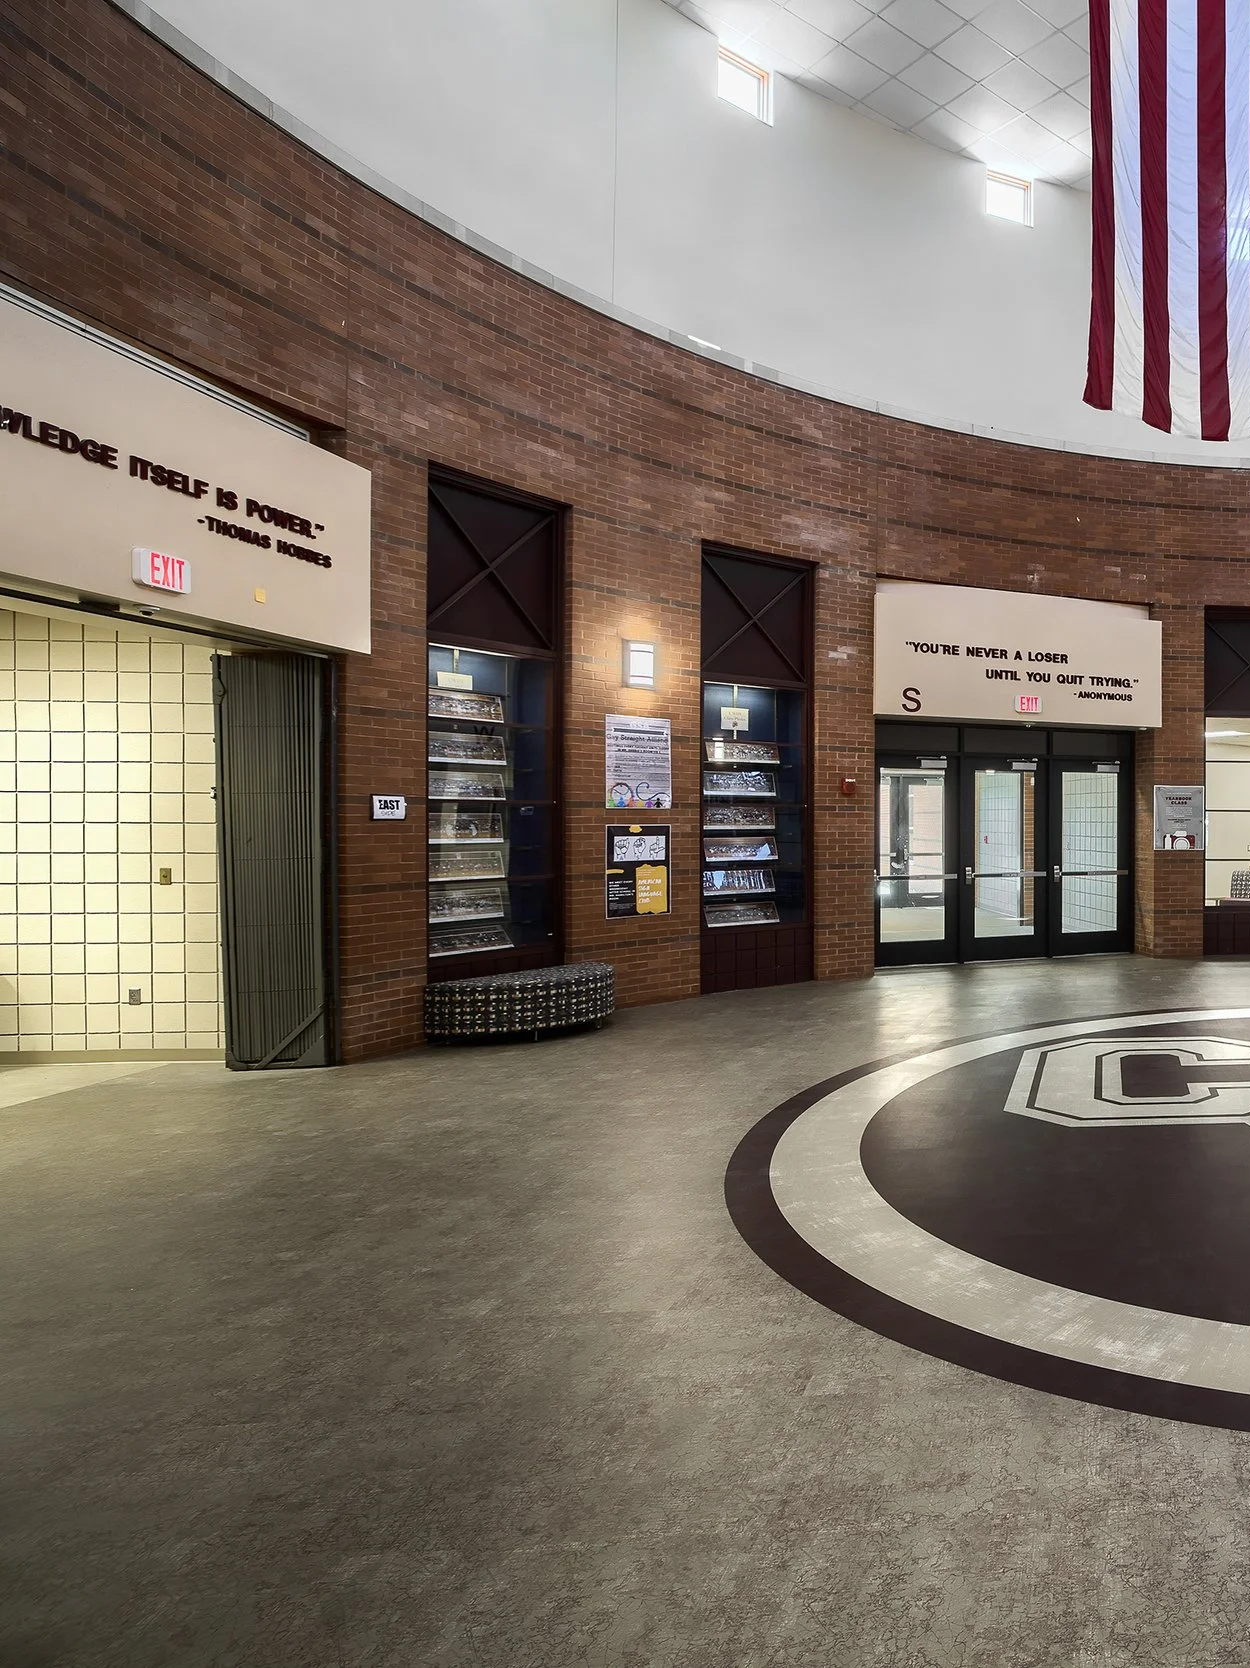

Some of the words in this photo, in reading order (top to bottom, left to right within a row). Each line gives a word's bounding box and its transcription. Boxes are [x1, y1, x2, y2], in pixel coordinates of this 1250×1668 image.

[129, 455, 209, 499] ITSELF
[216, 487, 238, 511] IS
[277, 539, 332, 569] HOBBES
[150, 551, 185, 591] EXIT
[966, 646, 1008, 660] NEVER
[1014, 650, 1022, 661] A
[1028, 651, 1068, 664] LOSER
[986, 669, 1021, 682] UNTIL
[1026, 671, 1051, 683] YOU
[1057, 674, 1085, 687] QUIT
[901, 687, 922, 713] S
[1020, 696, 1039, 712] EXIT
[378, 800, 400, 810] EAST
